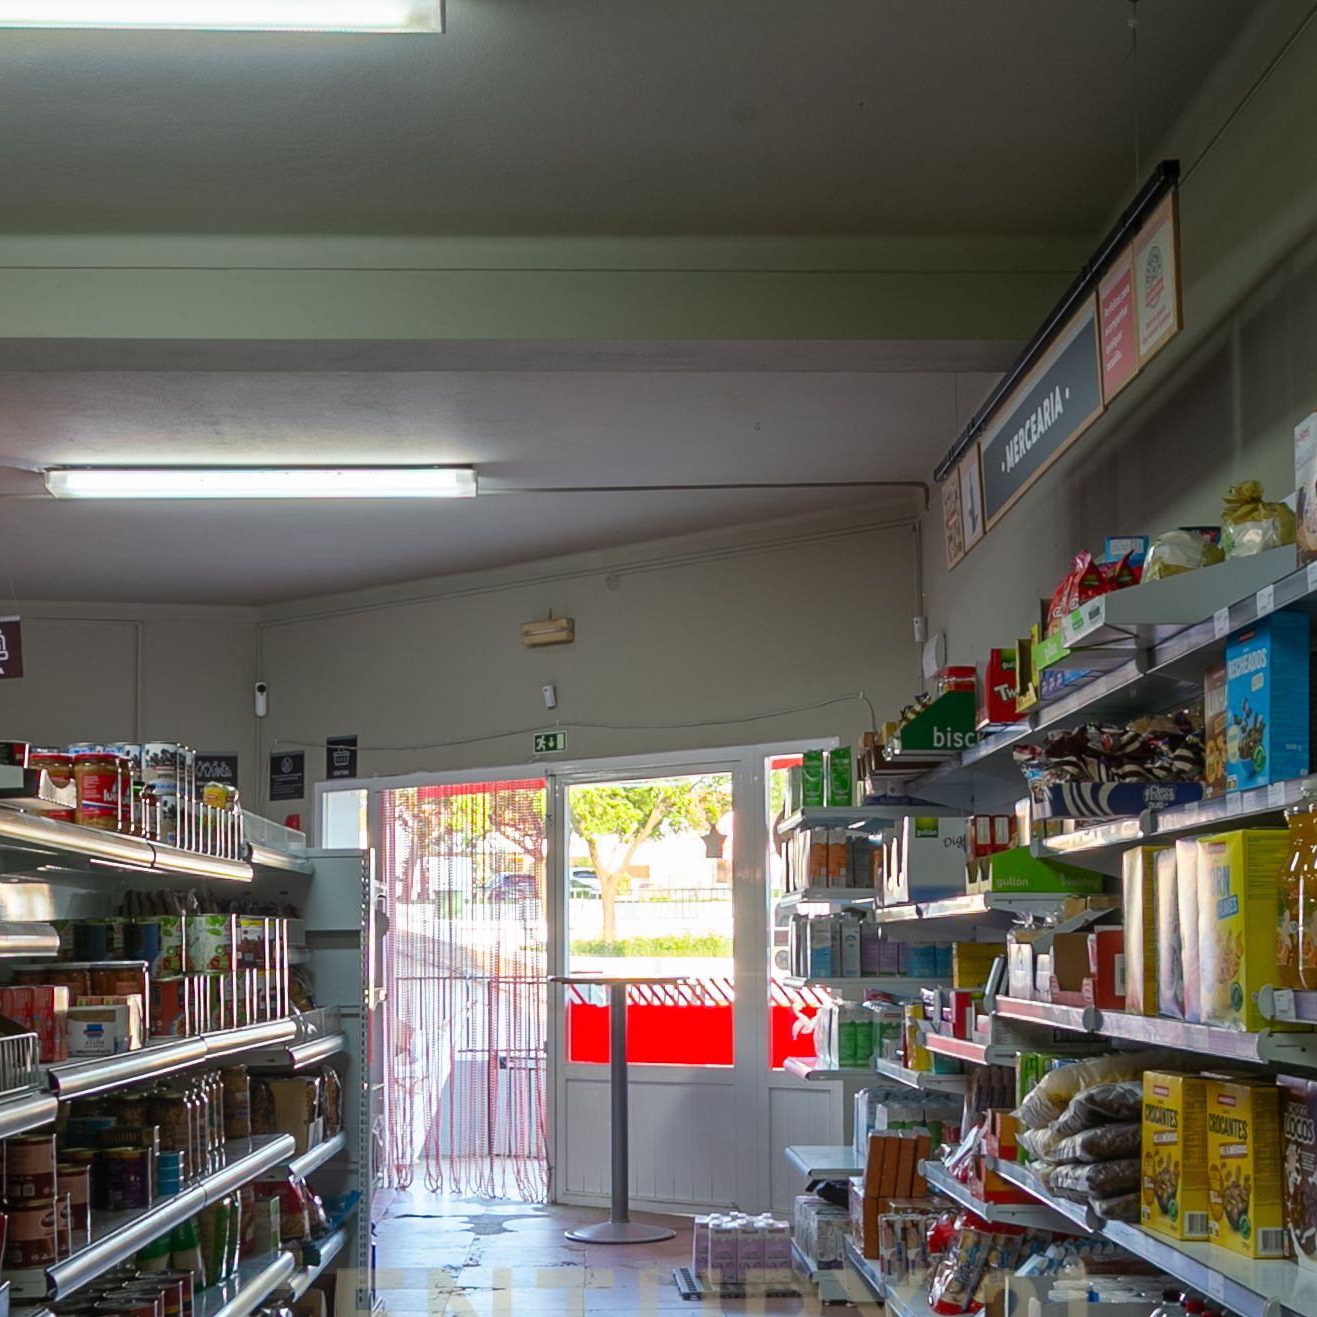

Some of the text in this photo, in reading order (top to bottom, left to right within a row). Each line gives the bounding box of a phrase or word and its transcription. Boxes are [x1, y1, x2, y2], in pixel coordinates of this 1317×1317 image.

[1004, 386, 1063, 472] MERCEARIA
[1144, 1103, 1179, 1129] CROCANTES
[1208, 1112, 1248, 1141] CROCANTES
[1285, 1113, 1315, 1144] LOCOS
